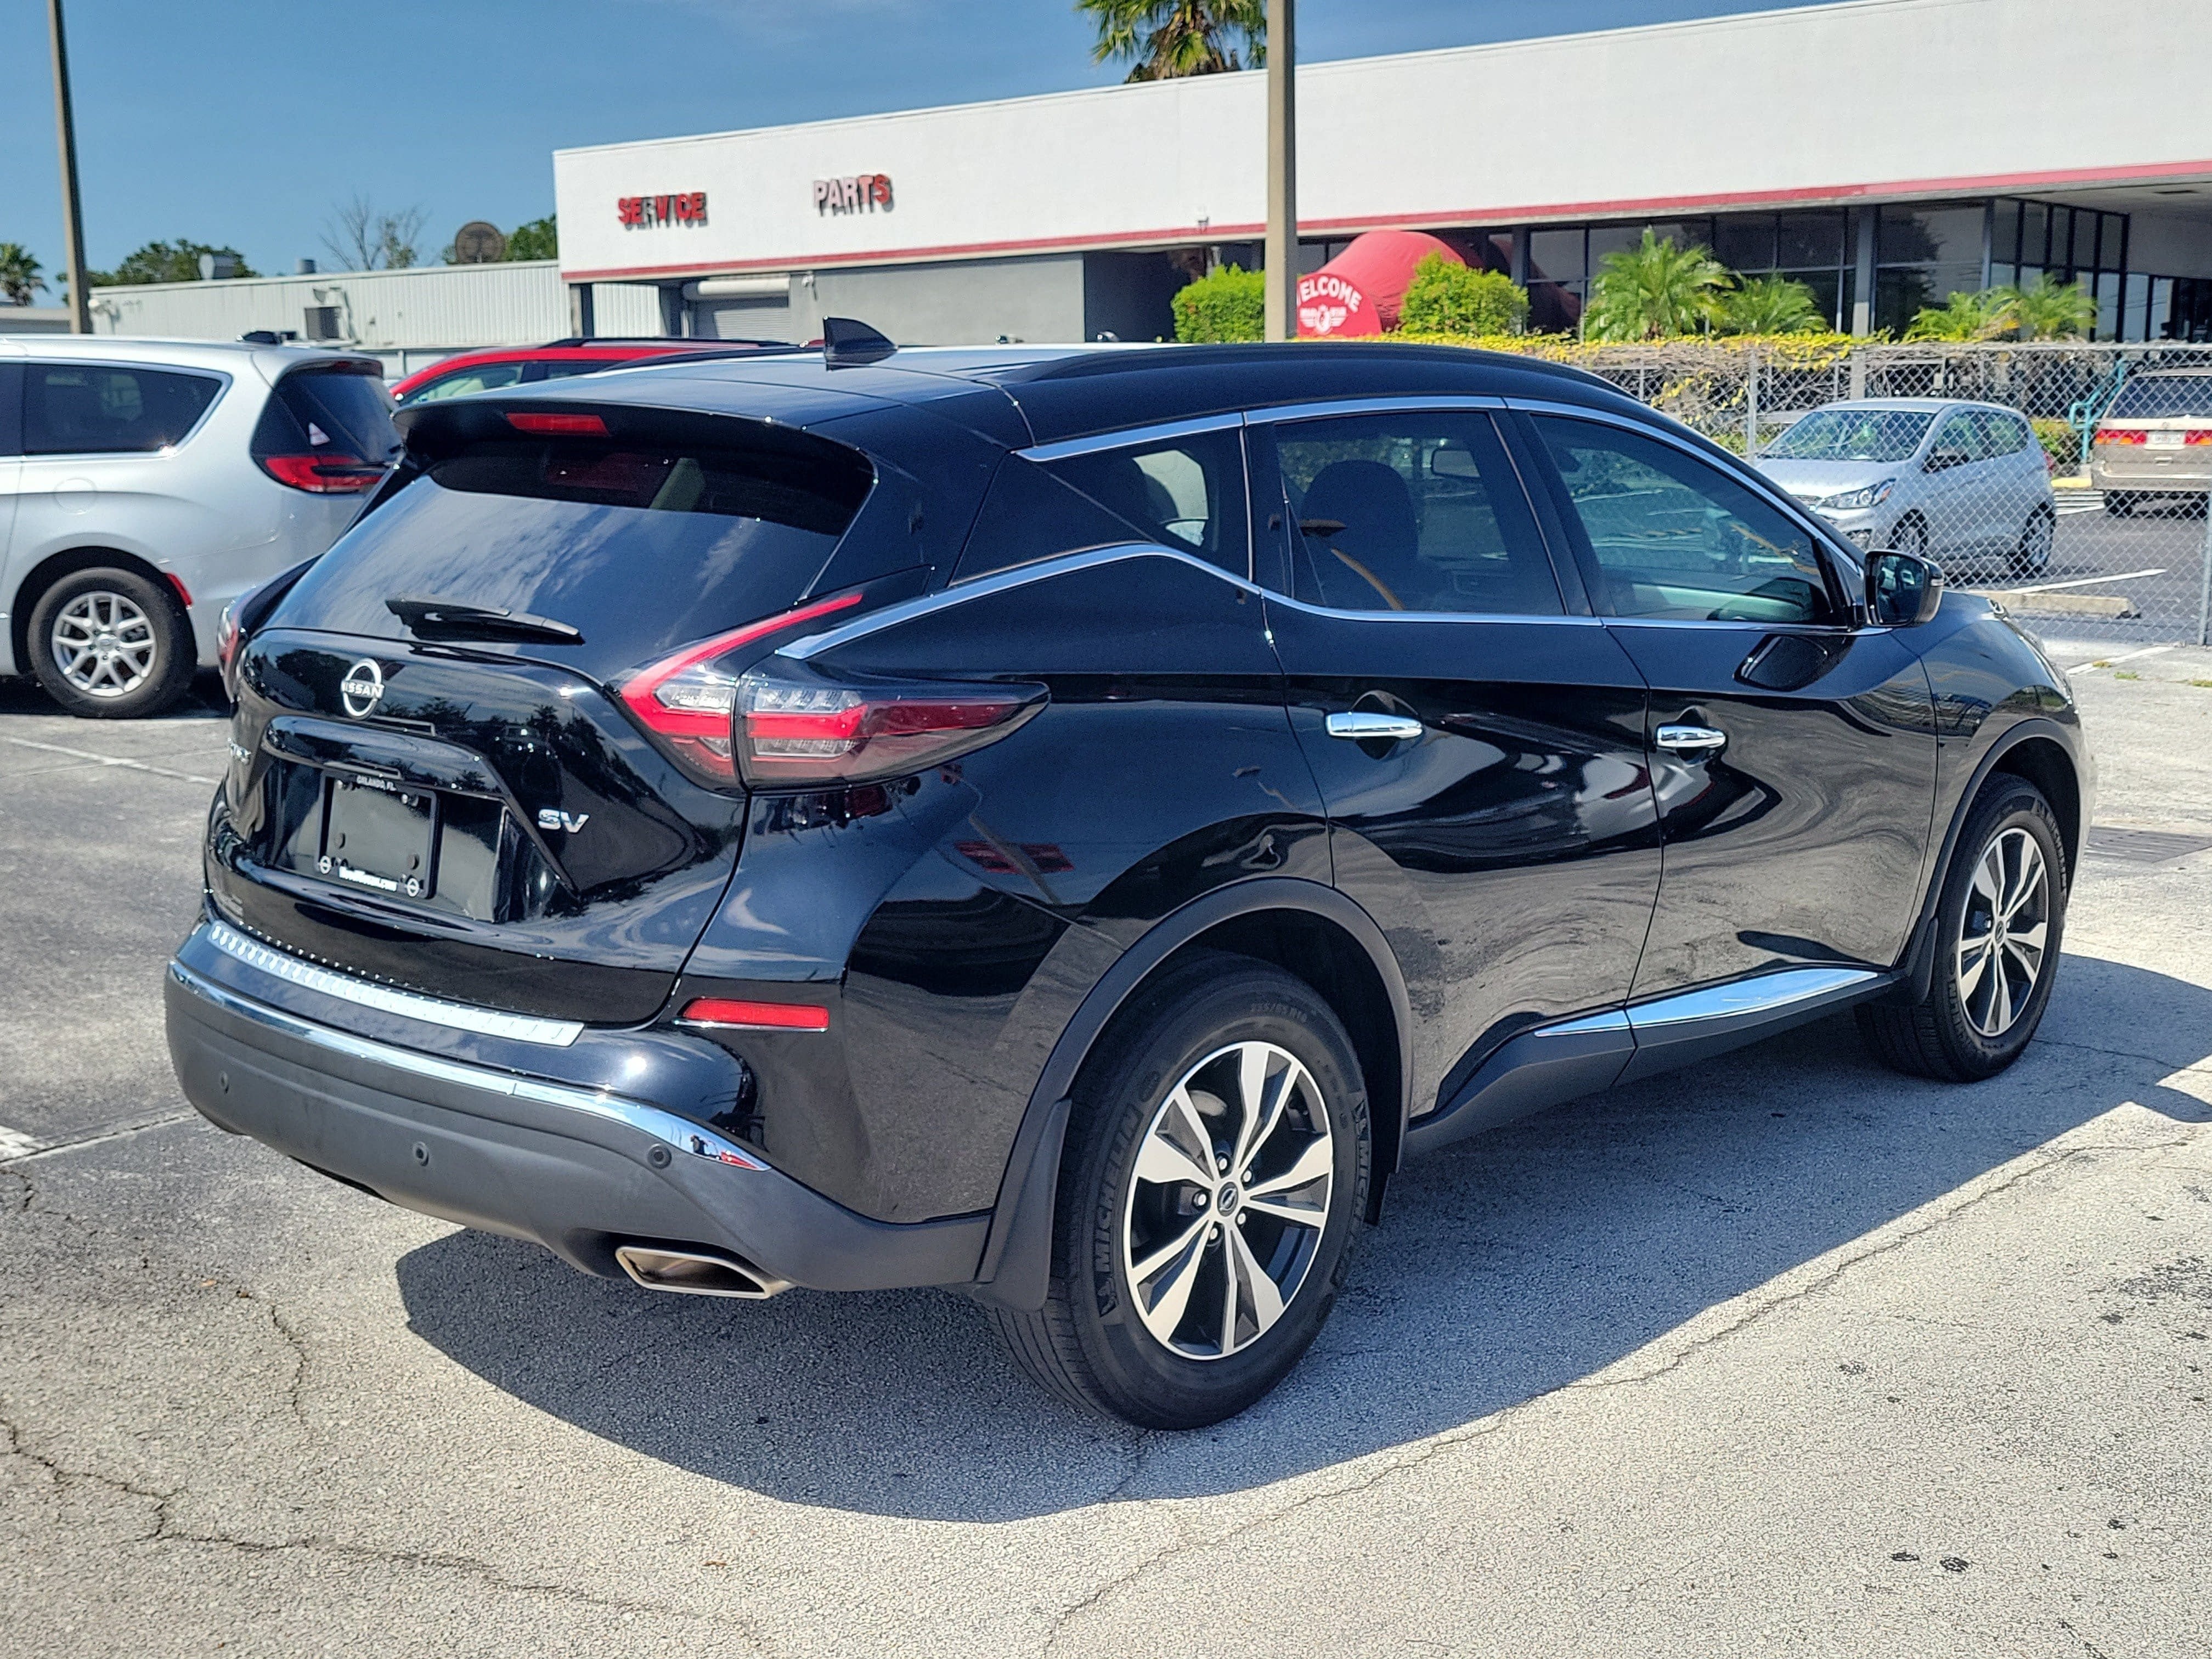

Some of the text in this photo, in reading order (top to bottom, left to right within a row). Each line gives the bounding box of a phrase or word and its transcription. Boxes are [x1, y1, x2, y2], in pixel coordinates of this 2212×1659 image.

[814, 174, 891, 208] PARTS
[539, 809, 589, 833] SV
[1094, 1106, 1139, 1272] MICHELIN
